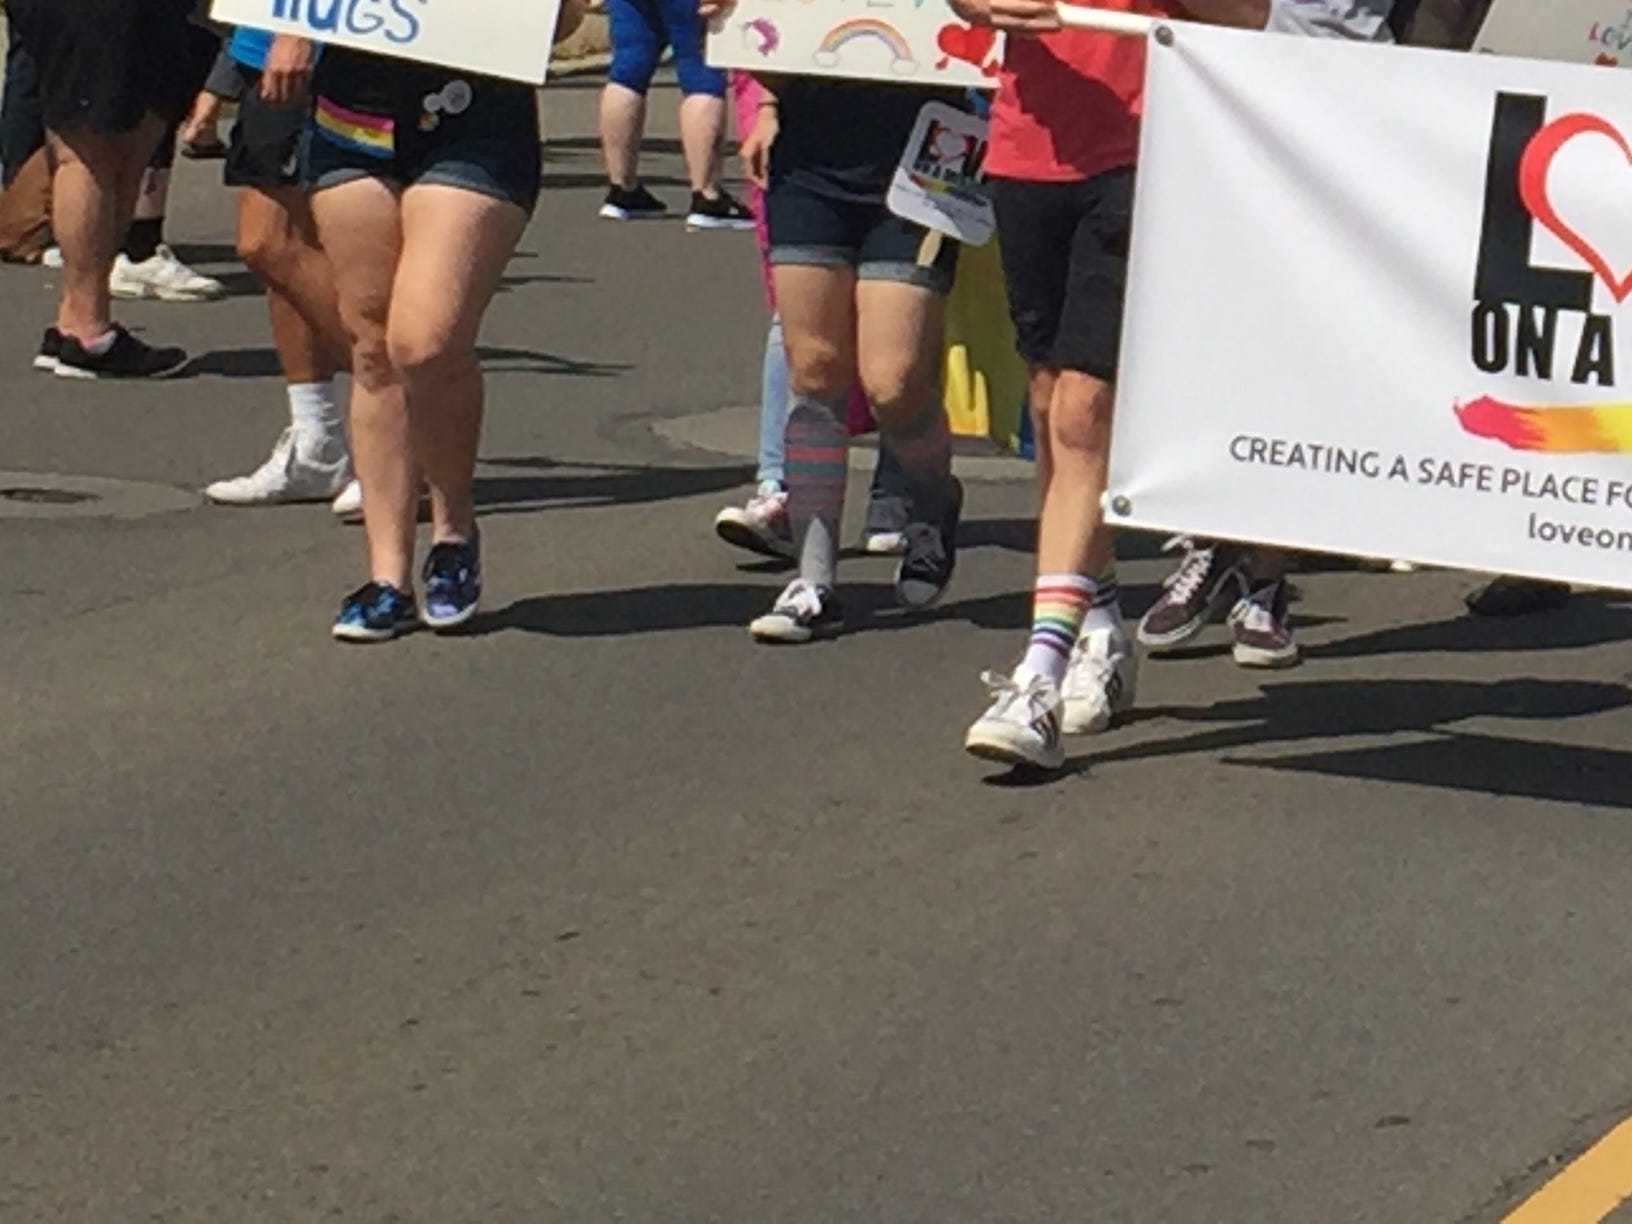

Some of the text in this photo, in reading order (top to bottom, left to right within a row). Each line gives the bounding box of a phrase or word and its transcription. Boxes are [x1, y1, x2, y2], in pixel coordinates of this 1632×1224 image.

[1471, 300, 1558, 381] ON
[1570, 309, 1615, 387] A
[1229, 435, 1380, 478] CREATING
[1387, 456, 1410, 482] A
[1417, 458, 1494, 493] SAFE
[1500, 468, 1598, 506] PLACE
